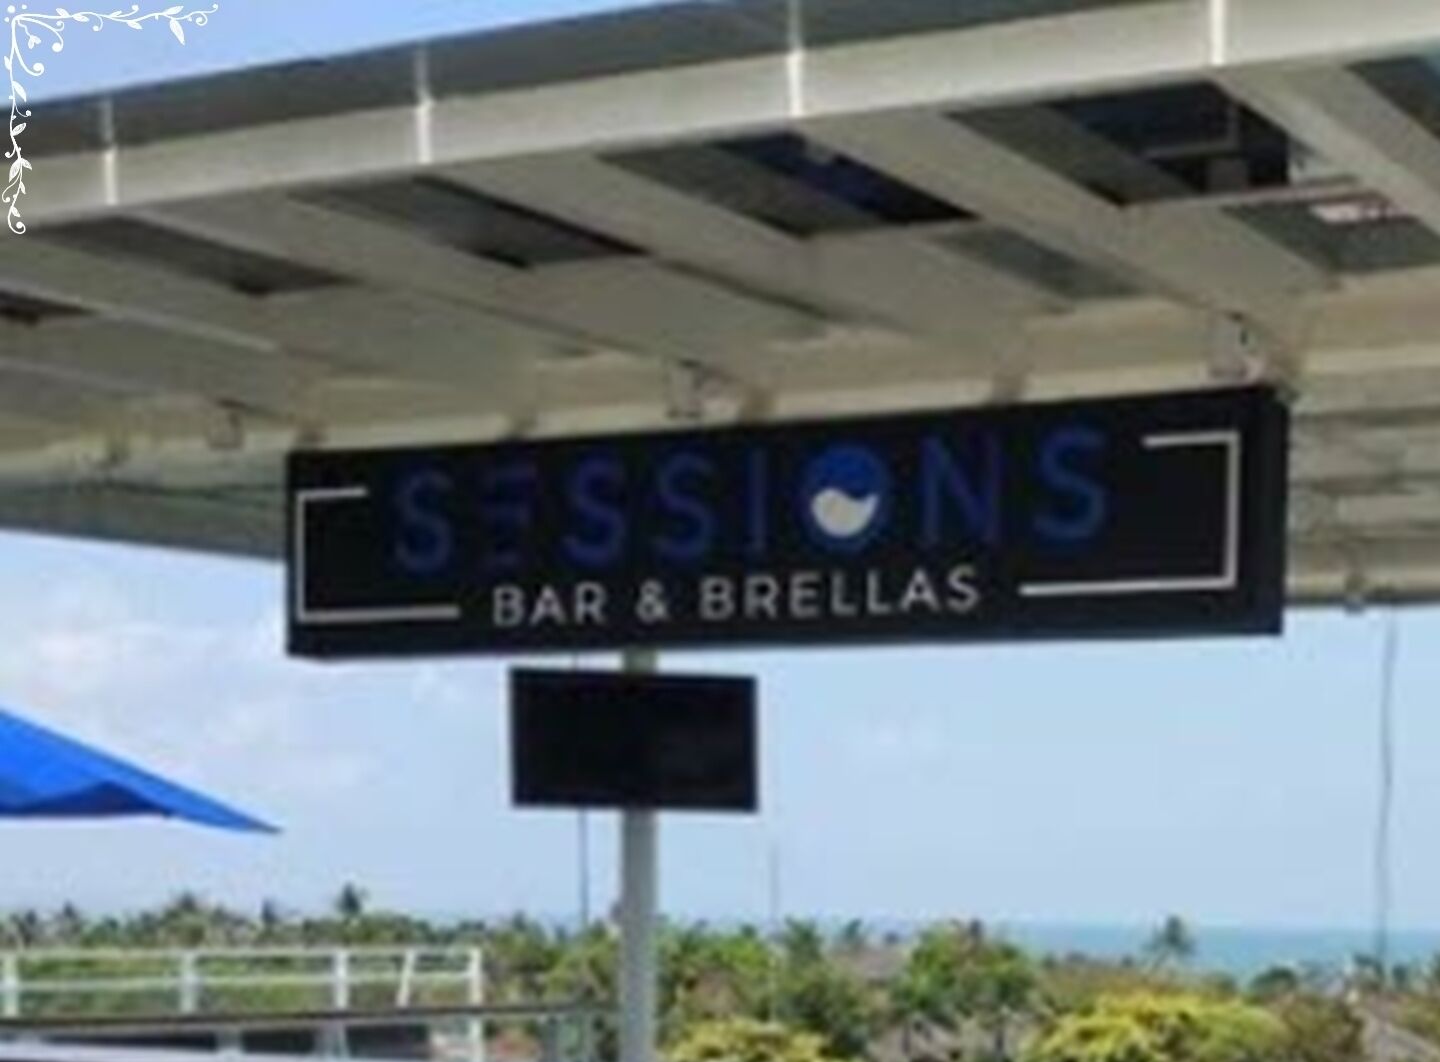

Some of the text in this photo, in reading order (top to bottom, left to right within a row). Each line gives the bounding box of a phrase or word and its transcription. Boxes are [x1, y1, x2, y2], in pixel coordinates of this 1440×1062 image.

[395, 425, 1111, 573] SESSIONS
[492, 566, 980, 627] BAR & BRELLAS
